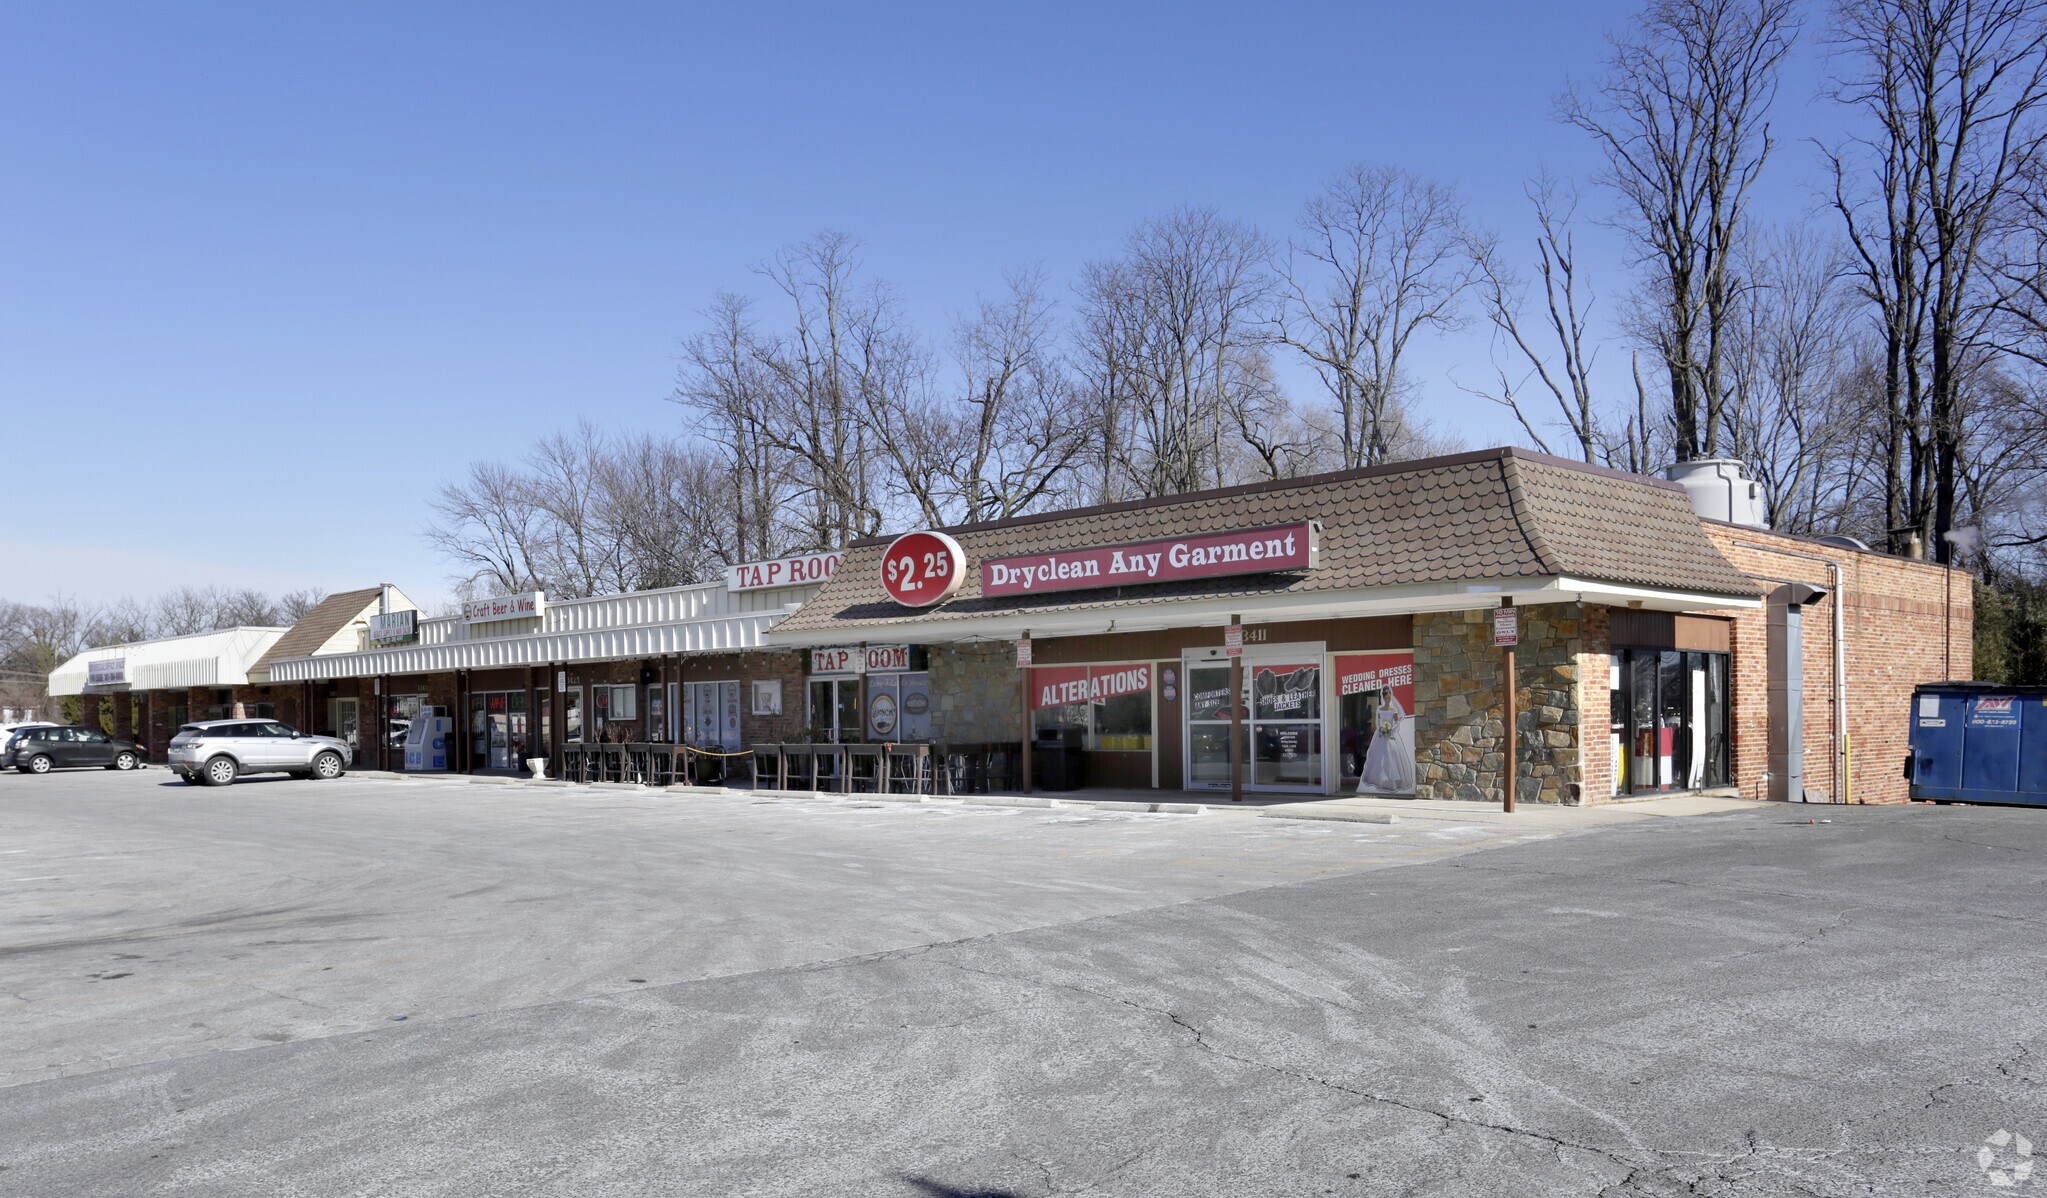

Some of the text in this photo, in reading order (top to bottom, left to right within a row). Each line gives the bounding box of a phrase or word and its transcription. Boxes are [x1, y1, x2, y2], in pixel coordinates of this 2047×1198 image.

[990, 531, 1296, 588] Dryclean Any Garment
[736, 555, 840, 588] TAP ROO
[473, 599, 534, 617] Craft Beer & Wine
[380, 611, 410, 629] MARIAN
[1241, 628, 1267, 642] 3411
[815, 651, 849, 671] TAP
[868, 647, 907, 668] OOM
[1341, 664, 1412, 685] WEDDING DRESSES
[1041, 667, 1148, 706] ALTERATIONS
[1342, 674, 1412, 695] CLEANED HERE
[1259, 695, 1279, 706] SHOES
[1288, 689, 1316, 701] LEATHER
[1274, 699, 1301, 712] JACKETS
[405, 751, 422, 765] ICE
